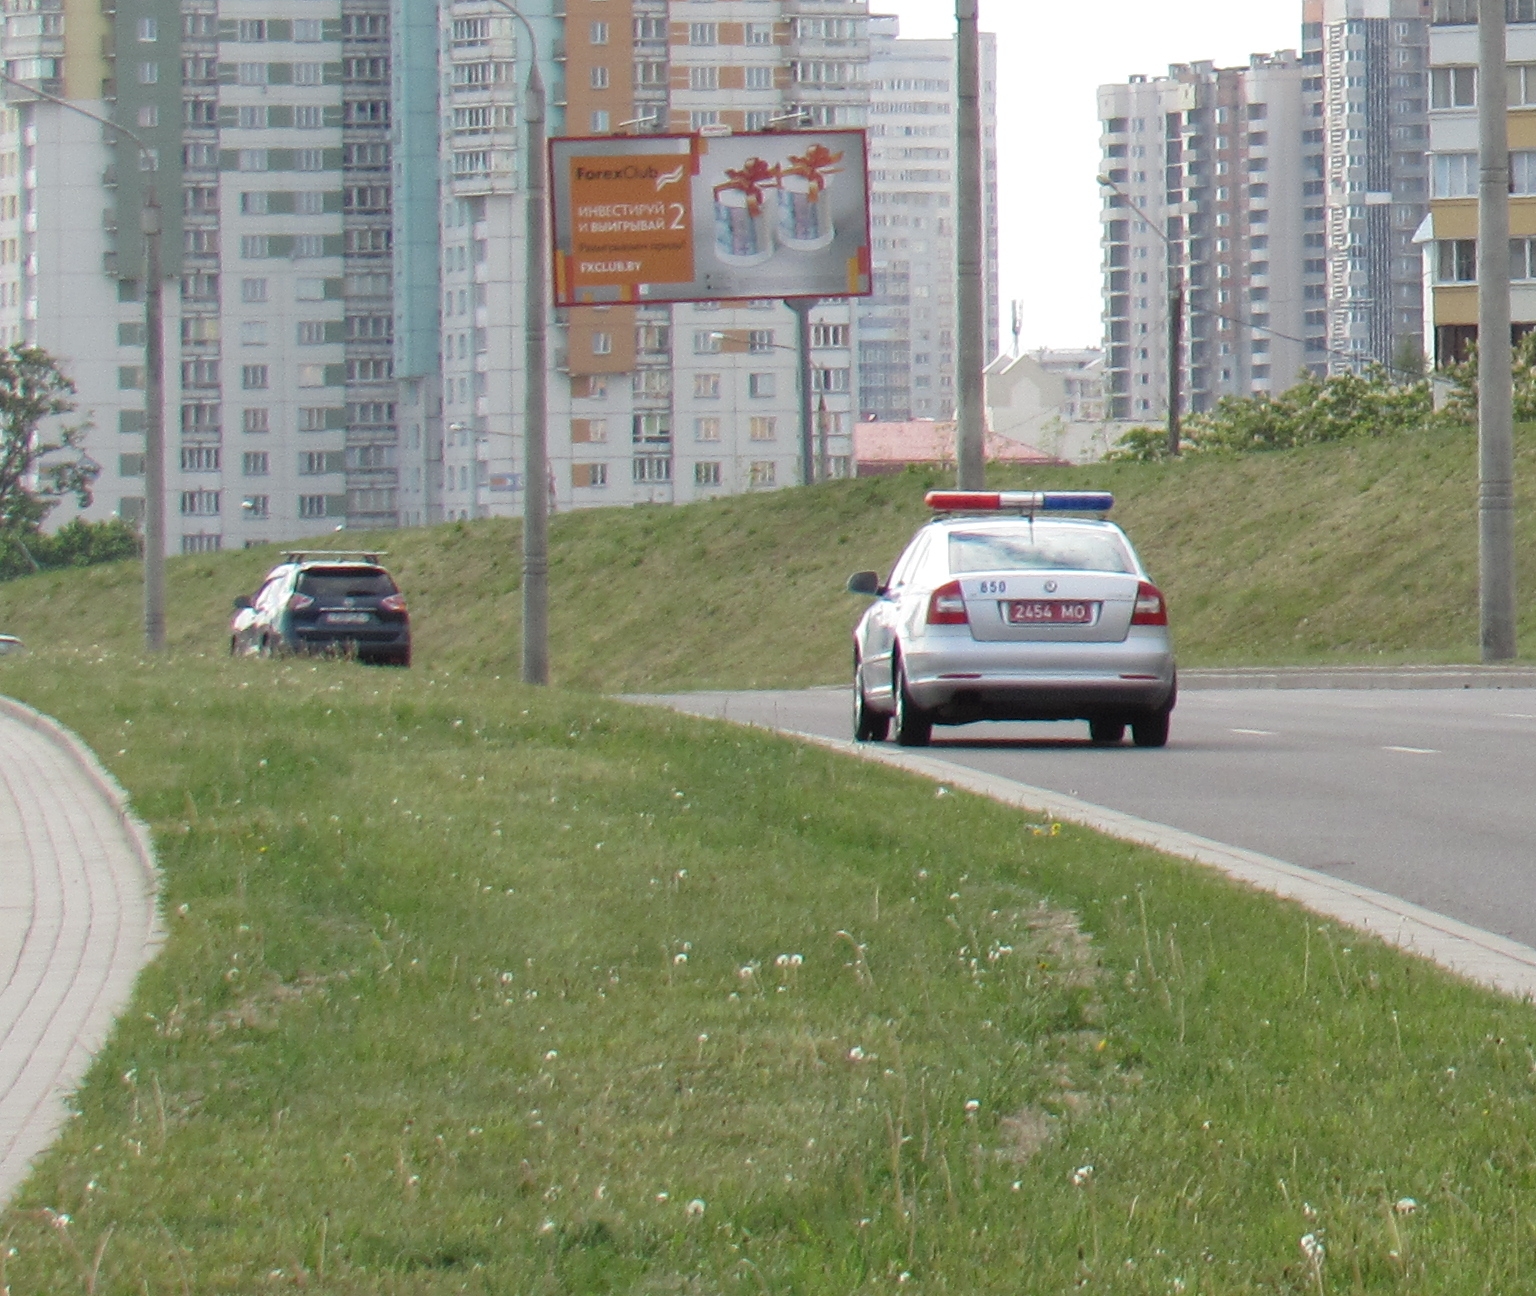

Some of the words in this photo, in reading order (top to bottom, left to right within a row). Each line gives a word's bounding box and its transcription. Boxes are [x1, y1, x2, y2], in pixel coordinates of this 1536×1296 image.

[577, 166, 658, 180] ForexClub
[578, 202, 665, 217] ИНВЕСТИРУЙ
[669, 203, 685, 230] 2
[578, 223, 588, 232] И
[591, 218, 665, 232] ВЫИГРЫВАЙ
[580, 261, 642, 273] FXCLUB.BY
[980, 581, 1007, 593] 850
[1015, 604, 1052, 618] 2454
[1062, 604, 1086, 618] MO
